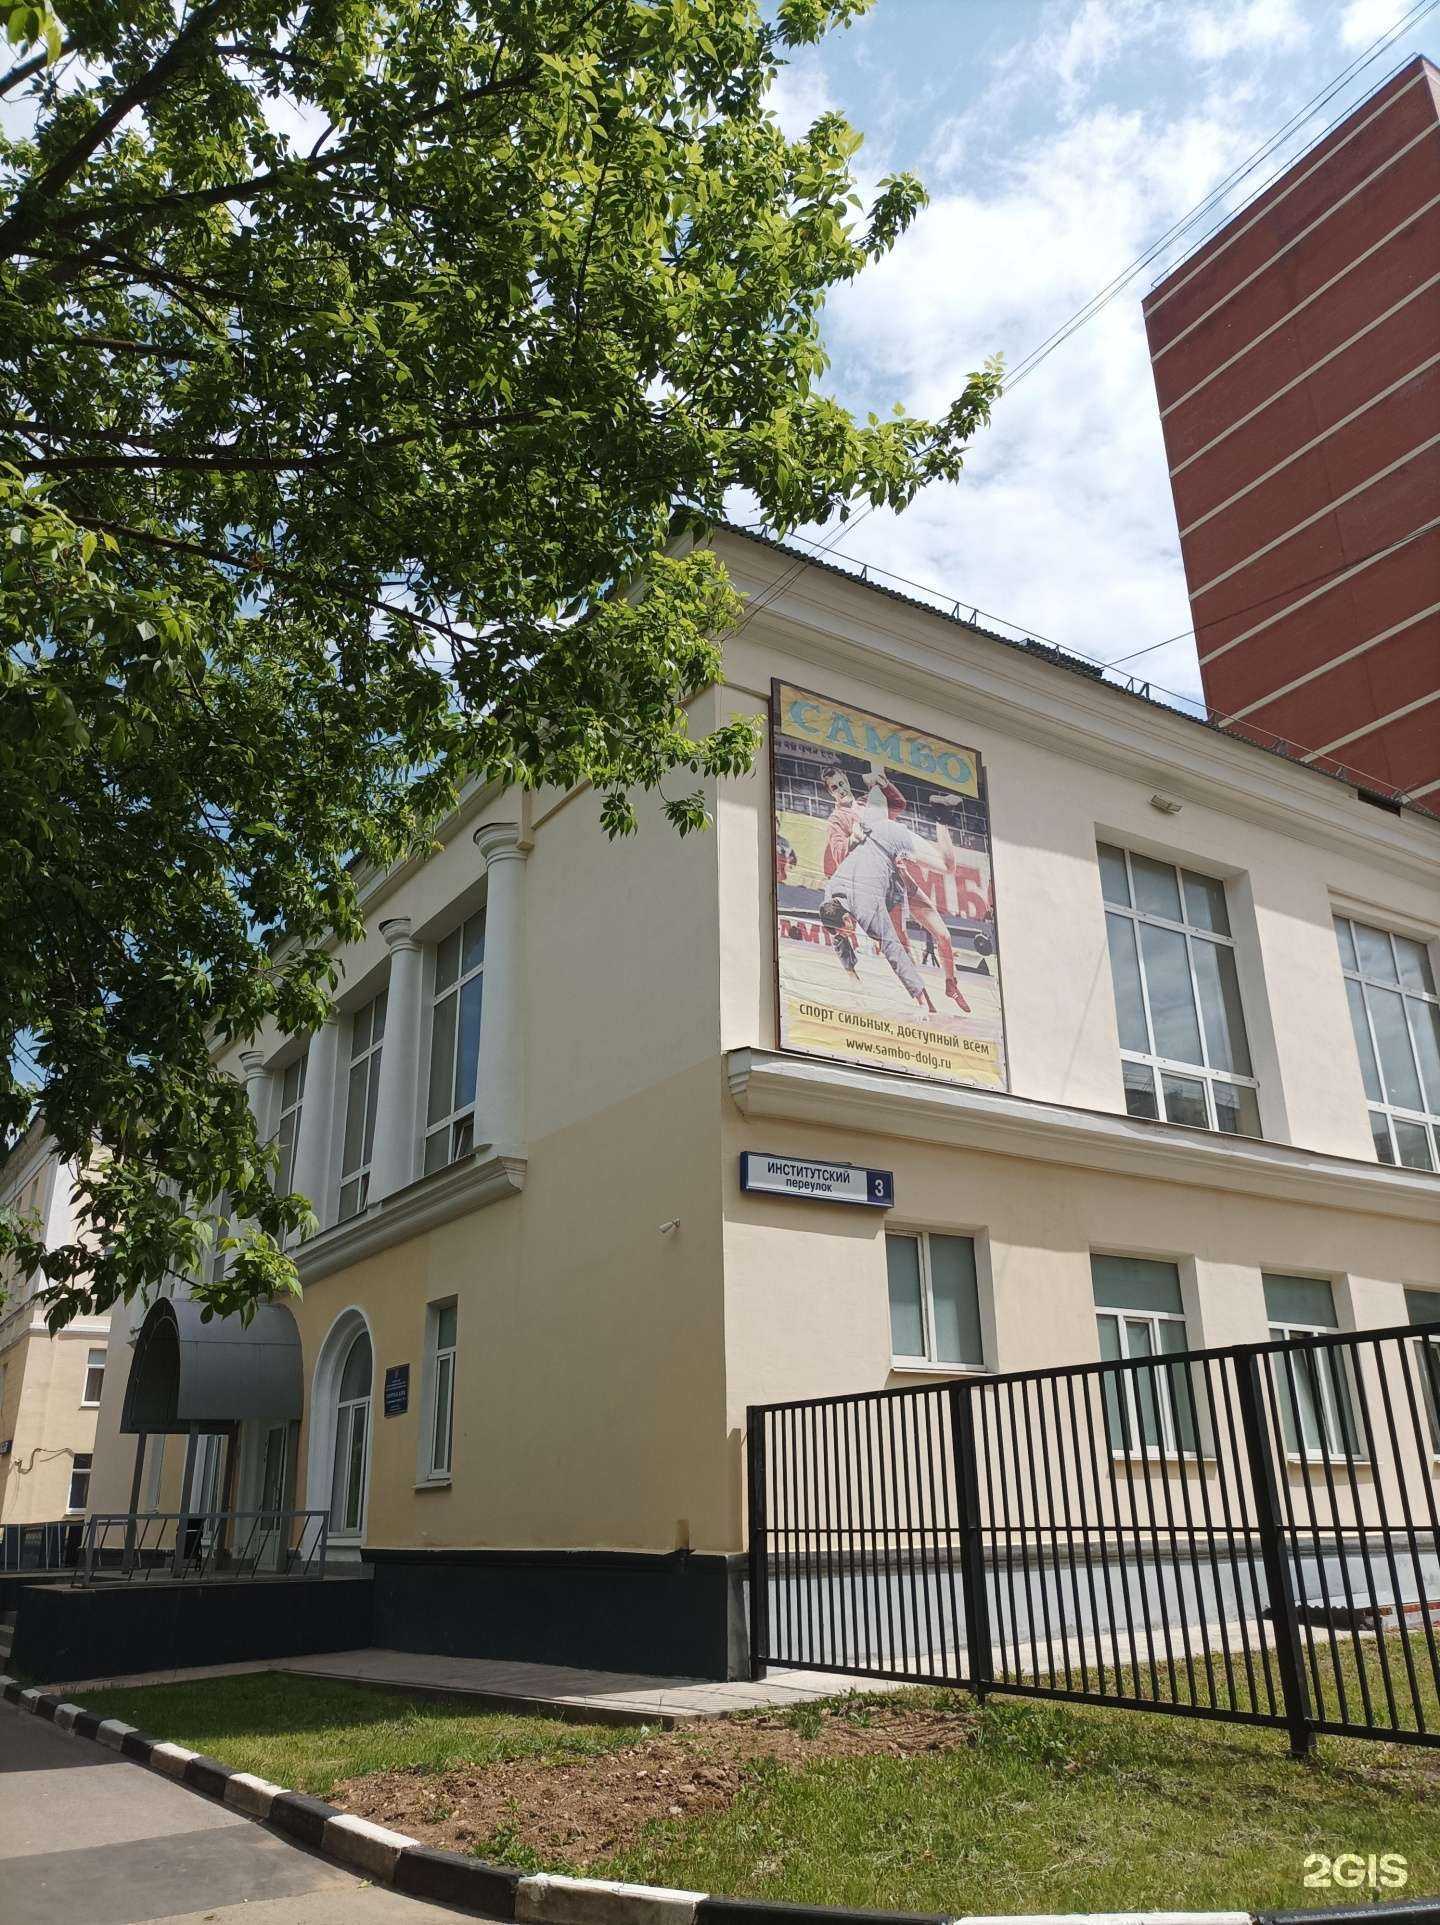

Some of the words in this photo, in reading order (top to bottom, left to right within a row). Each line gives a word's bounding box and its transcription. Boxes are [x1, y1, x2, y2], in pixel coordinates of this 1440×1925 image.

[788, 699, 972, 784] САМБО
[799, 1003, 834, 1022] спорт
[838, 1012, 894, 1035] сильных,
[896, 1025, 960, 1049] доступный
[963, 1039, 989, 1055] всем
[846, 1038, 952, 1070] www.sambo-dolg.ru
[767, 1160, 851, 1184] ИНСТИТУТСКИЙ
[786, 1177, 833, 1193] переулок
[874, 1179, 885, 1197] 3
